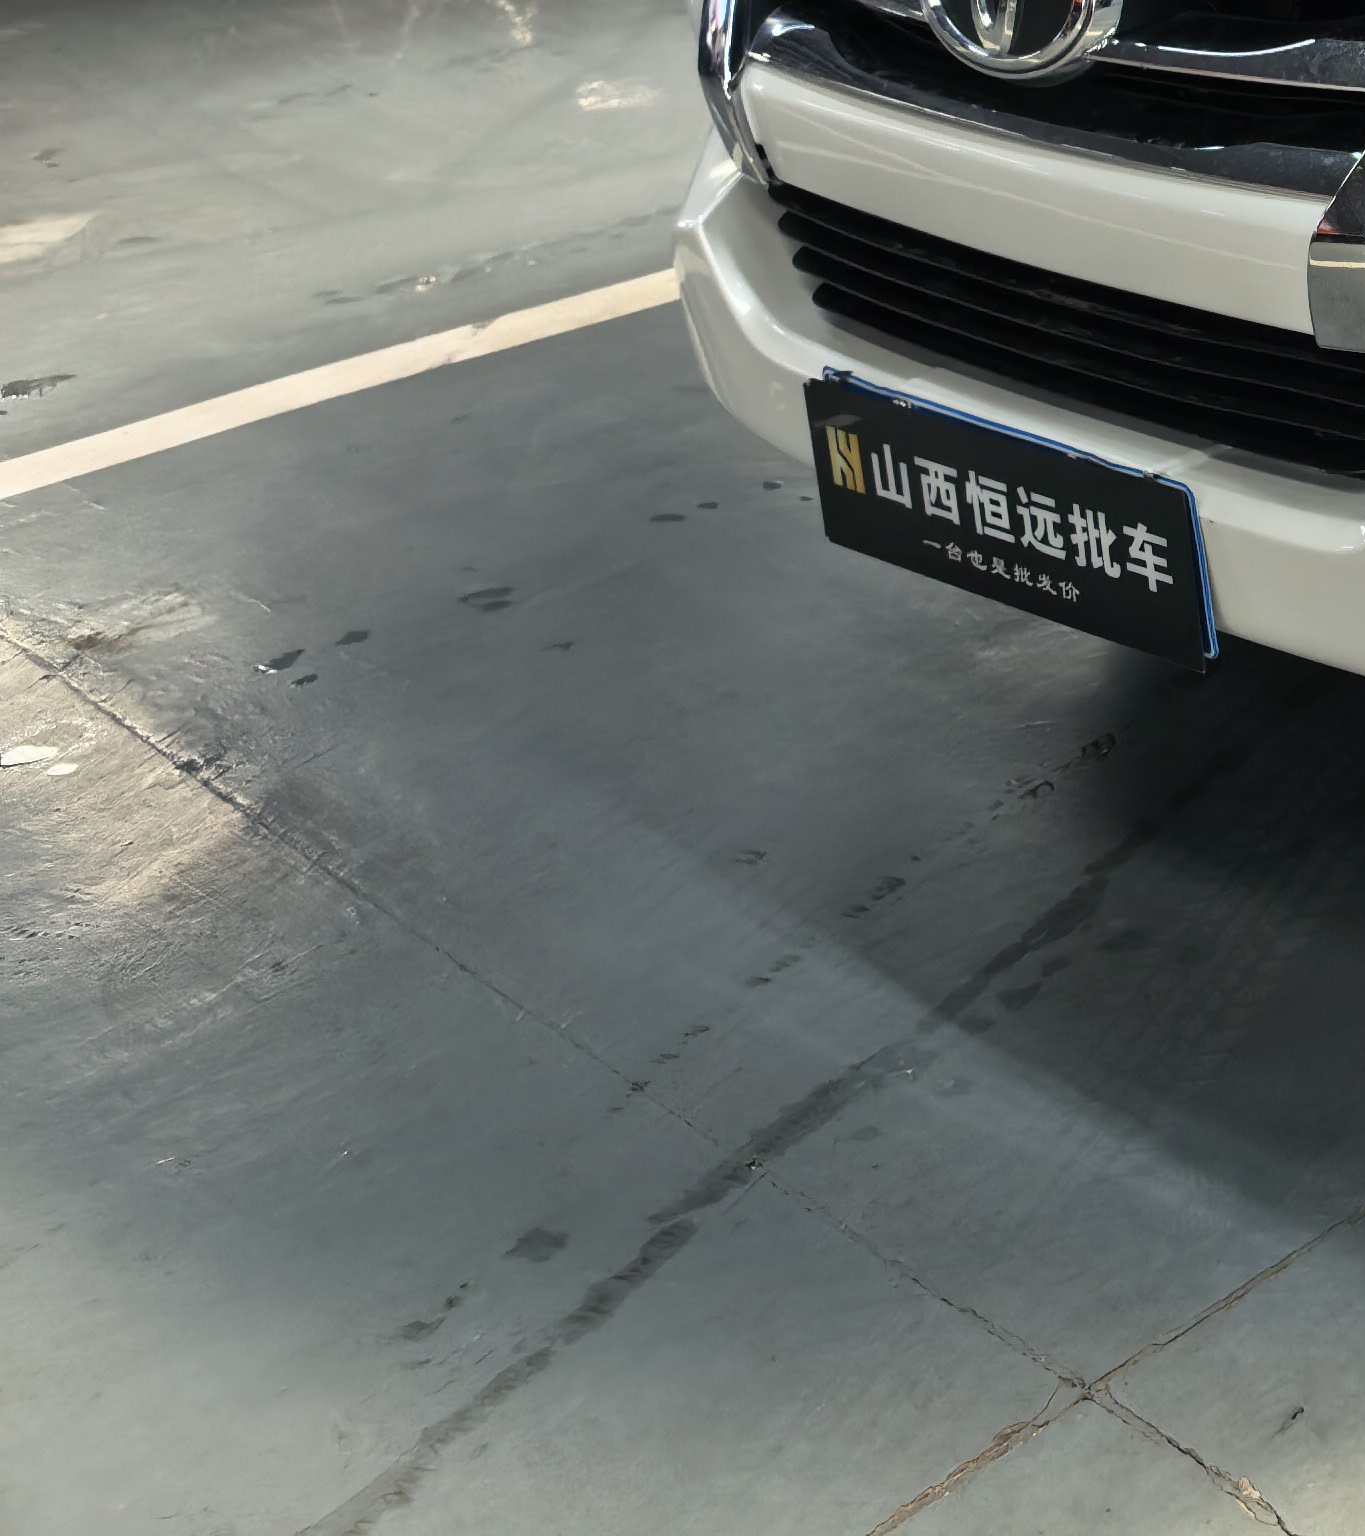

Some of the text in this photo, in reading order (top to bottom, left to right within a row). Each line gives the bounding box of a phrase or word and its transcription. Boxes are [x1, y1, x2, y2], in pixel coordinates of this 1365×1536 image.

[871, 443, 1174, 594] 山西恒远批车
[921, 539, 1080, 603] 一台也是批发价
